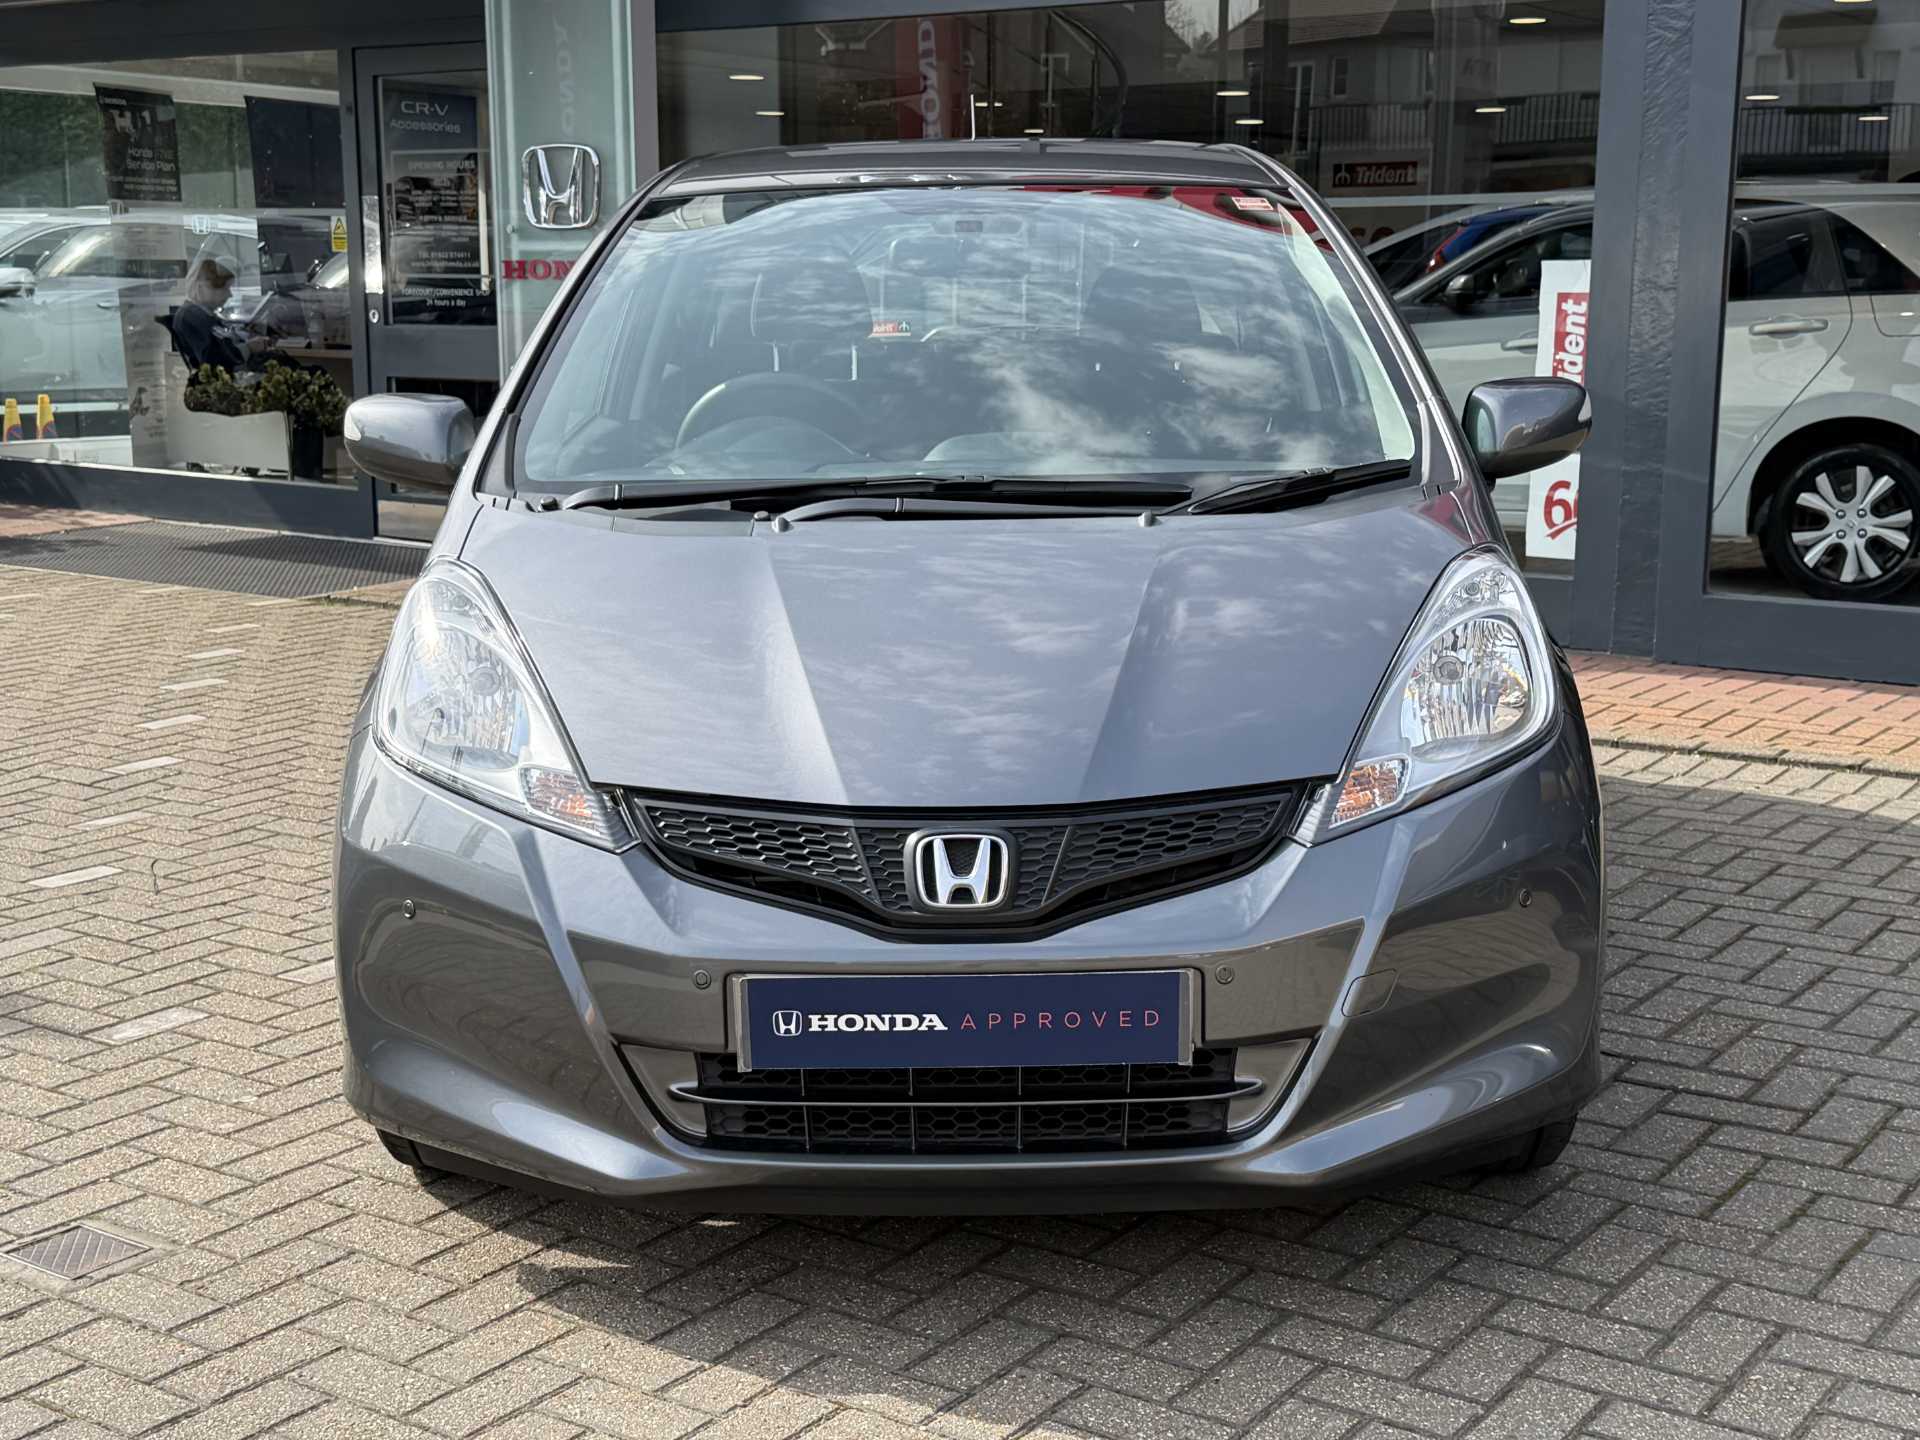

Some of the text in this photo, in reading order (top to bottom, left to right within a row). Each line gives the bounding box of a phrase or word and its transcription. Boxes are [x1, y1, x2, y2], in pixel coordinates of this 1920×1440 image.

[389, 119, 462, 134] Accessories
[156, 161, 176, 172] Plan
[1356, 164, 1416, 184] Trident
[1543, 480, 1578, 530] 6
[808, 1009, 1161, 1032] HONDA APPROVED
